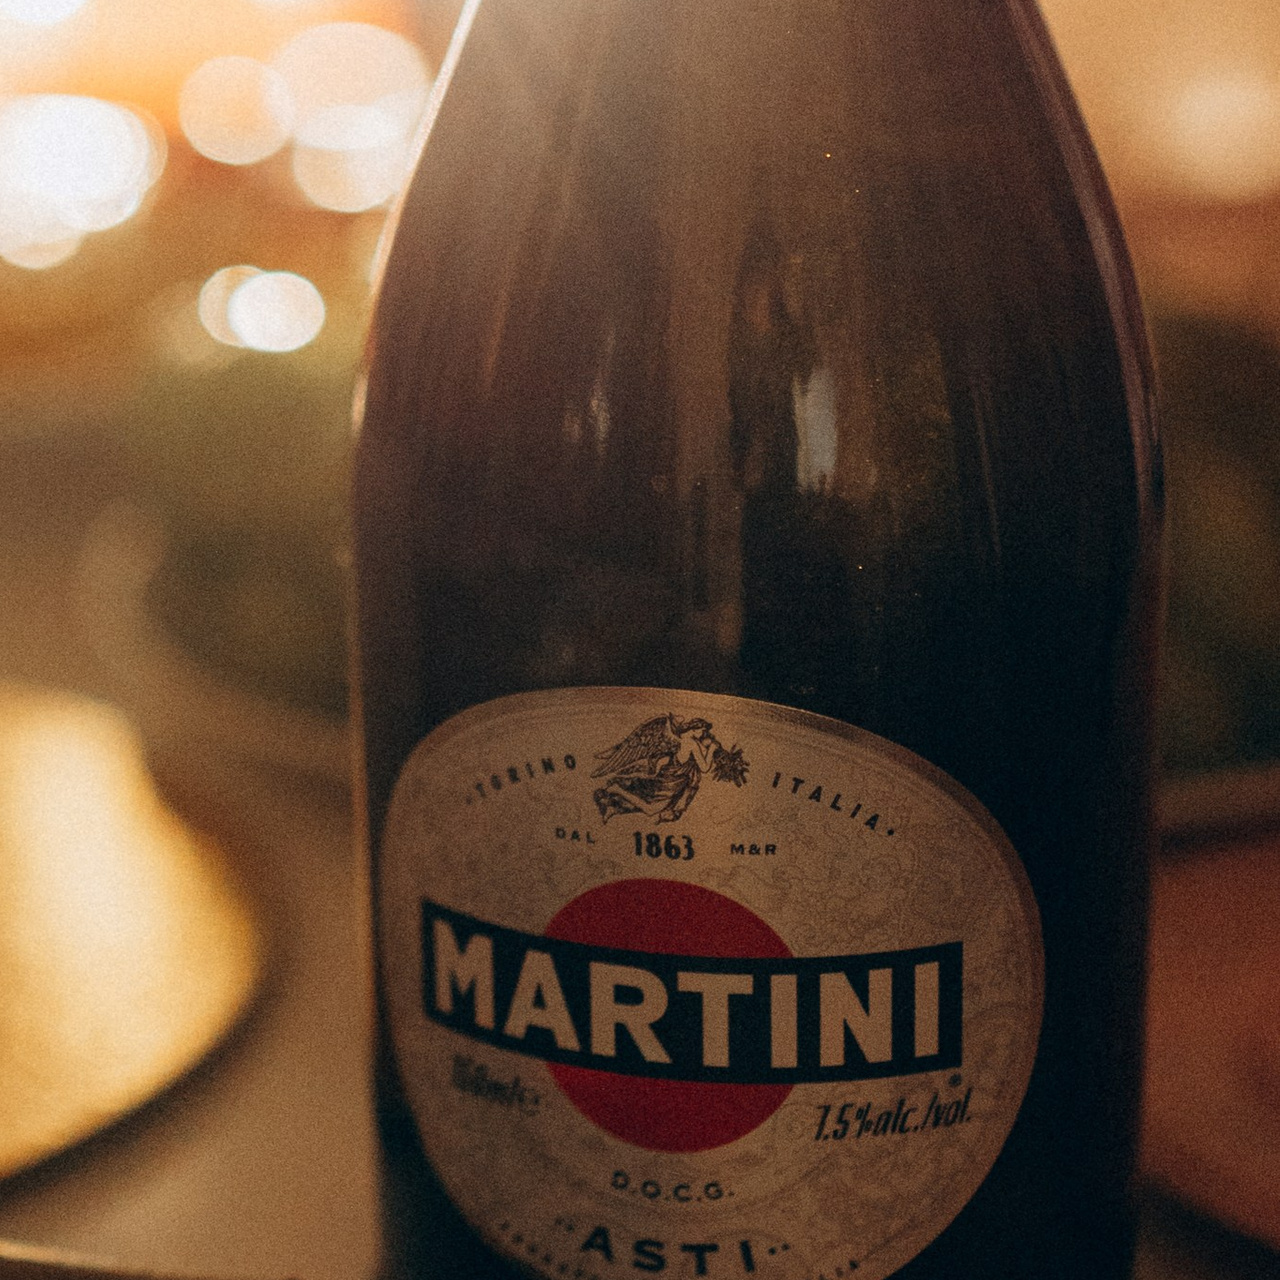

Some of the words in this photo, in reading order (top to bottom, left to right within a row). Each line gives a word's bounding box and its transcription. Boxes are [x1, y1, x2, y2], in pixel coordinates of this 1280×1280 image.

[474, 754, 577, 799] TORINO
[772, 772, 880, 832] ITALIA
[554, 827, 597, 844] DAL
[632, 830, 696, 860] 1863
[729, 843, 779, 856] M&R
[433, 919, 940, 1069] MARTINI
